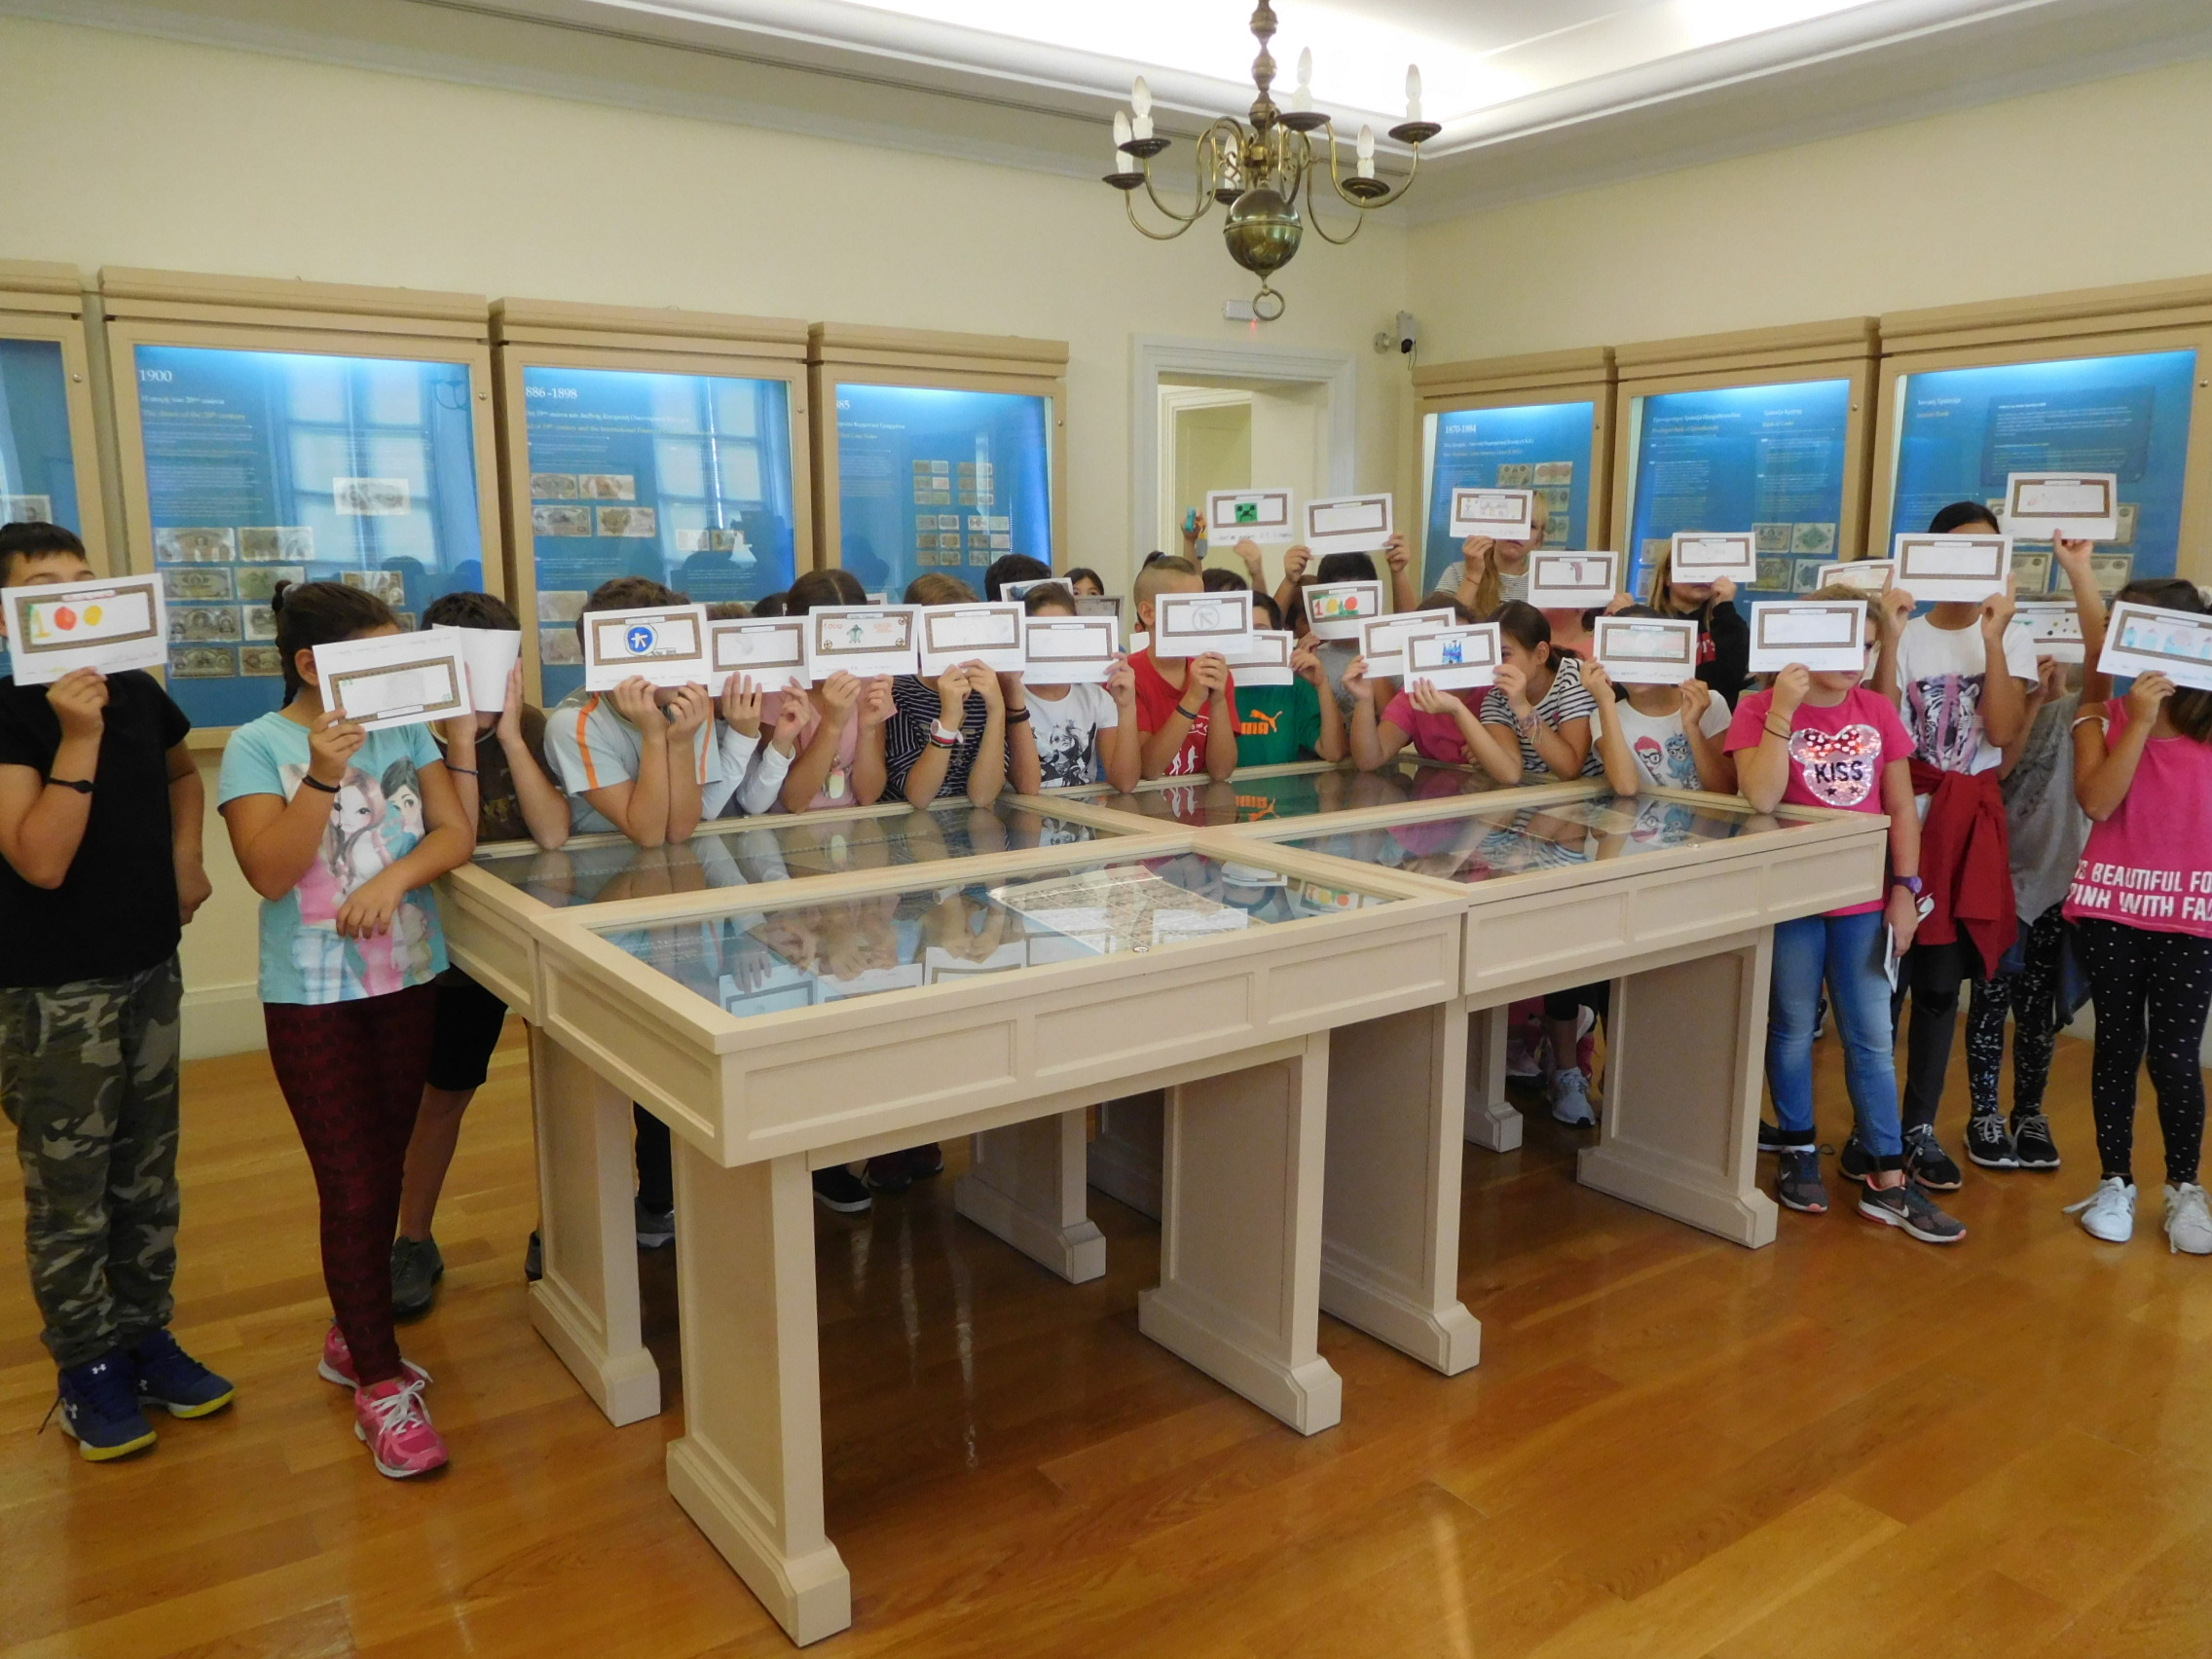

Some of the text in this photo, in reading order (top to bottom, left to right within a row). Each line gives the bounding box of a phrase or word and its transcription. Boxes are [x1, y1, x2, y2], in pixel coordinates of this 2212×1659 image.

[140, 370, 173, 382] 1900
[526, 387, 545, 398] 886
[836, 400, 850, 410] 85
[1814, 760, 1863, 784] KISS
[2091, 863, 2183, 892] BEAUTIFUL
[2190, 871, 2212, 894] FO
[2119, 891, 2175, 917] WITH
